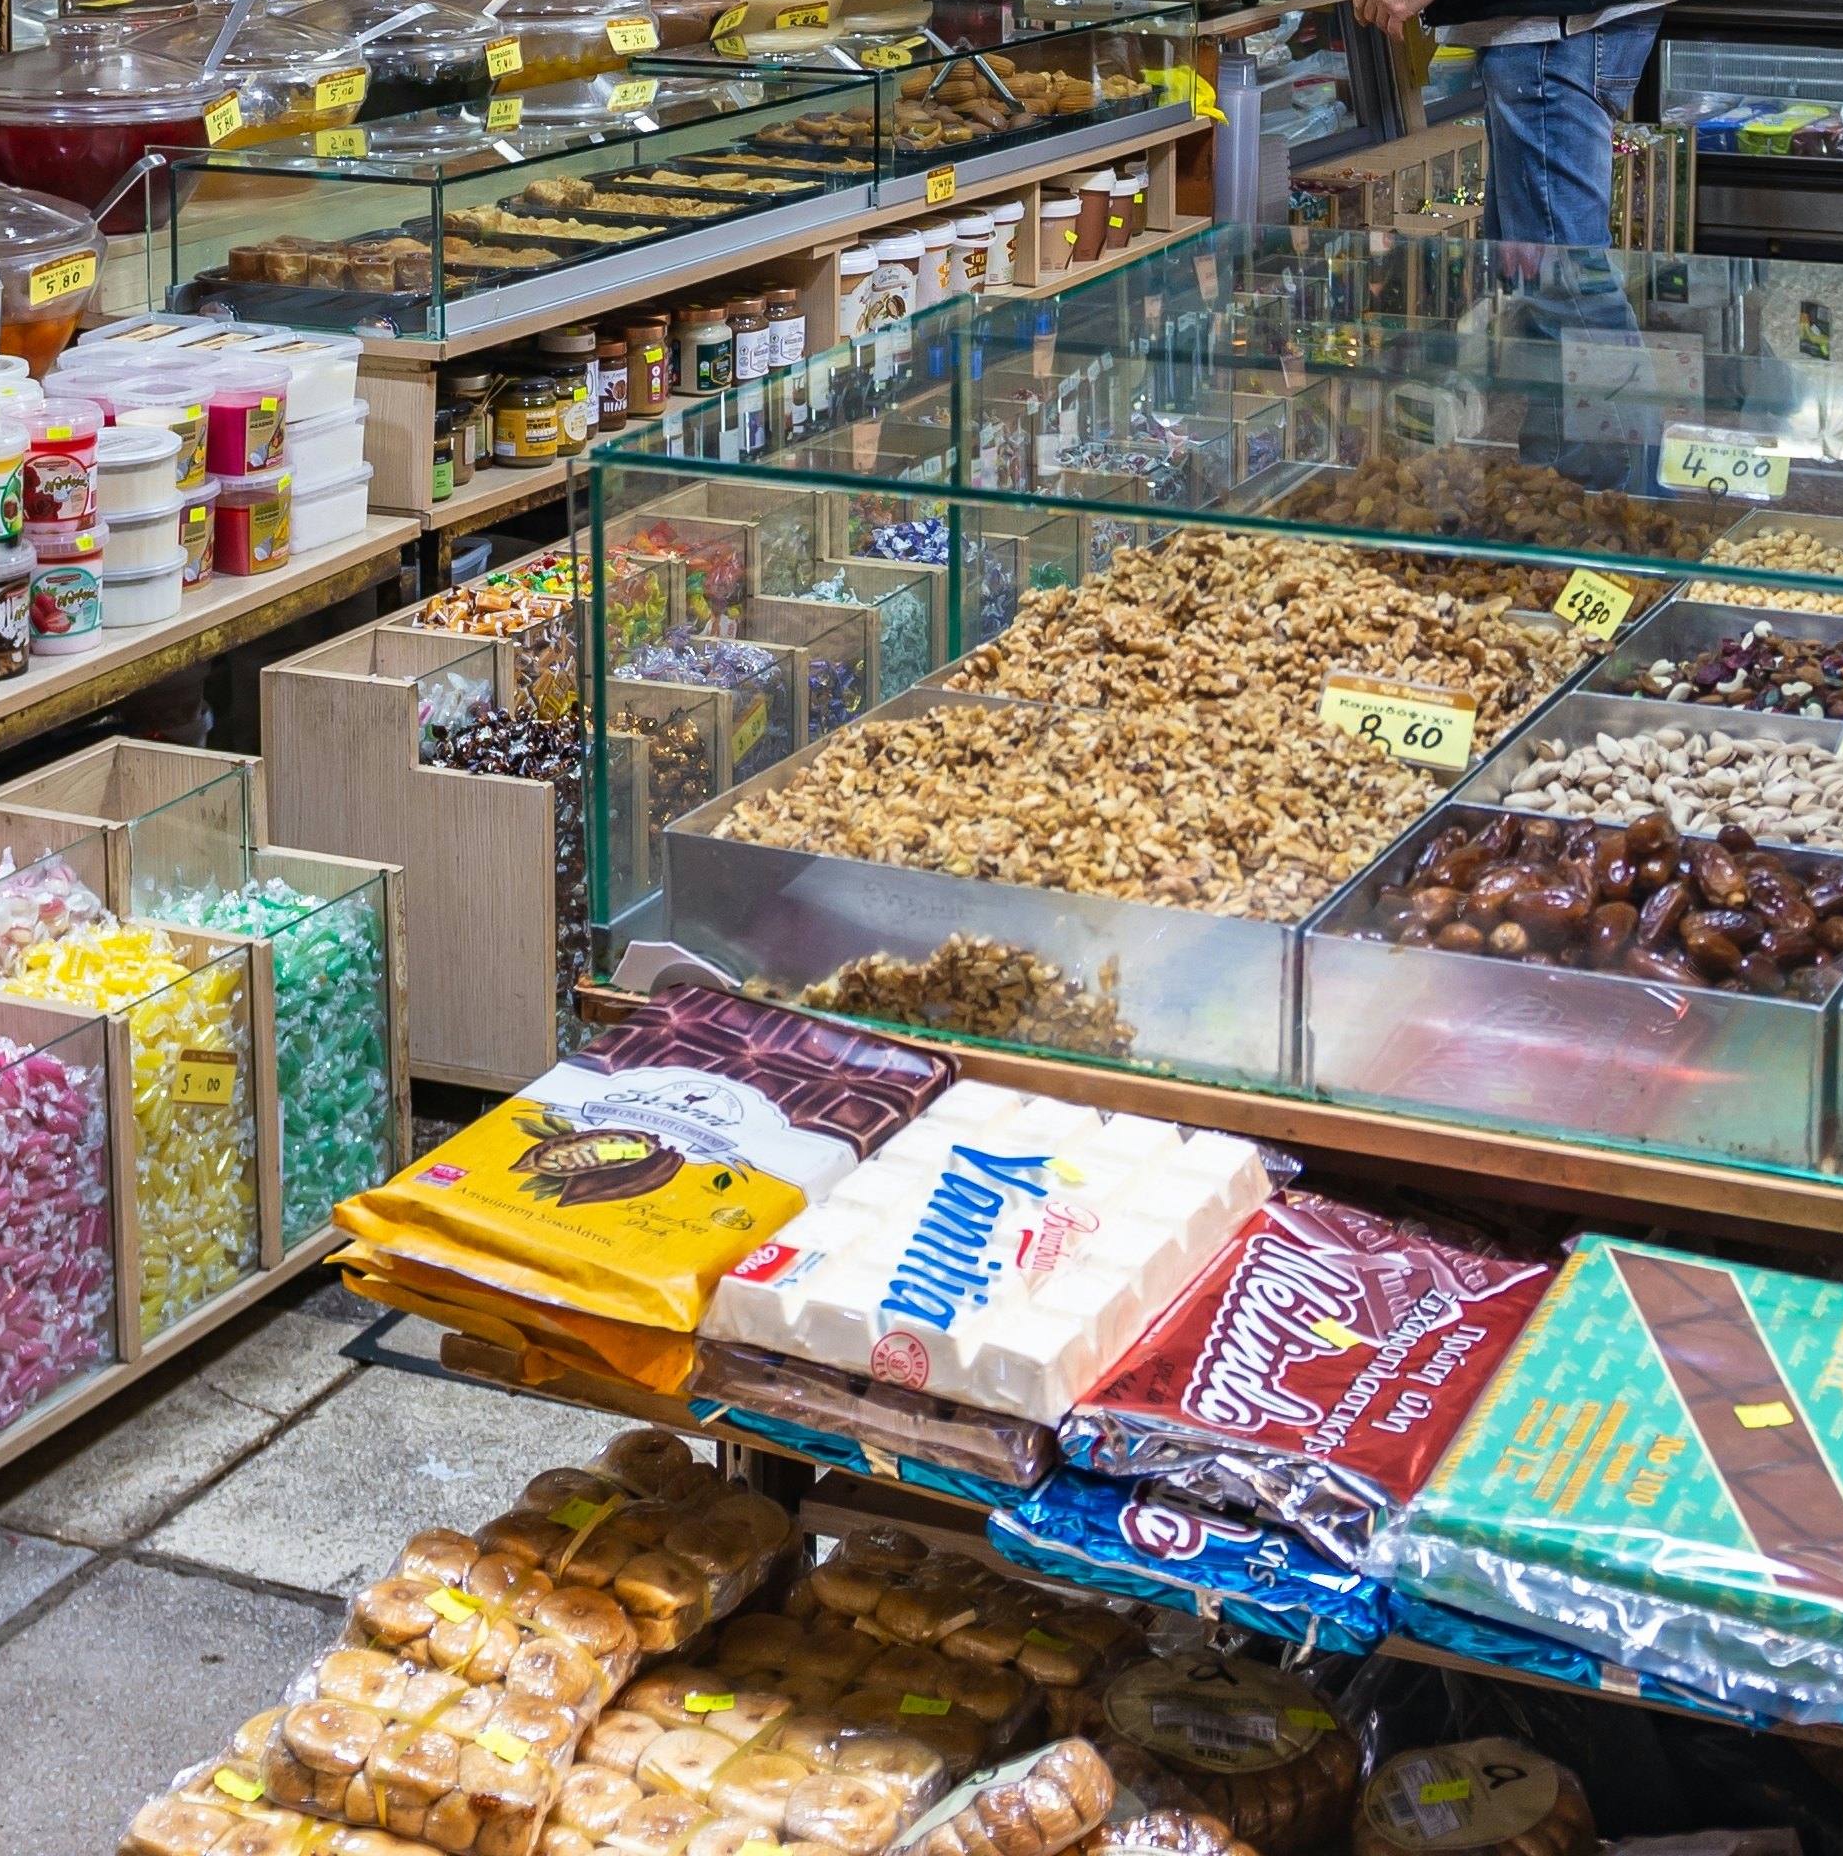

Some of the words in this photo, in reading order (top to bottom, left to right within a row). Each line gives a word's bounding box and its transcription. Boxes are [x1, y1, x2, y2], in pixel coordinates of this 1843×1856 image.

[46, 271, 81, 294] 5,80
[1196, 1236, 1358, 1431] Melinda
[1624, 1467, 1669, 1507] 100
